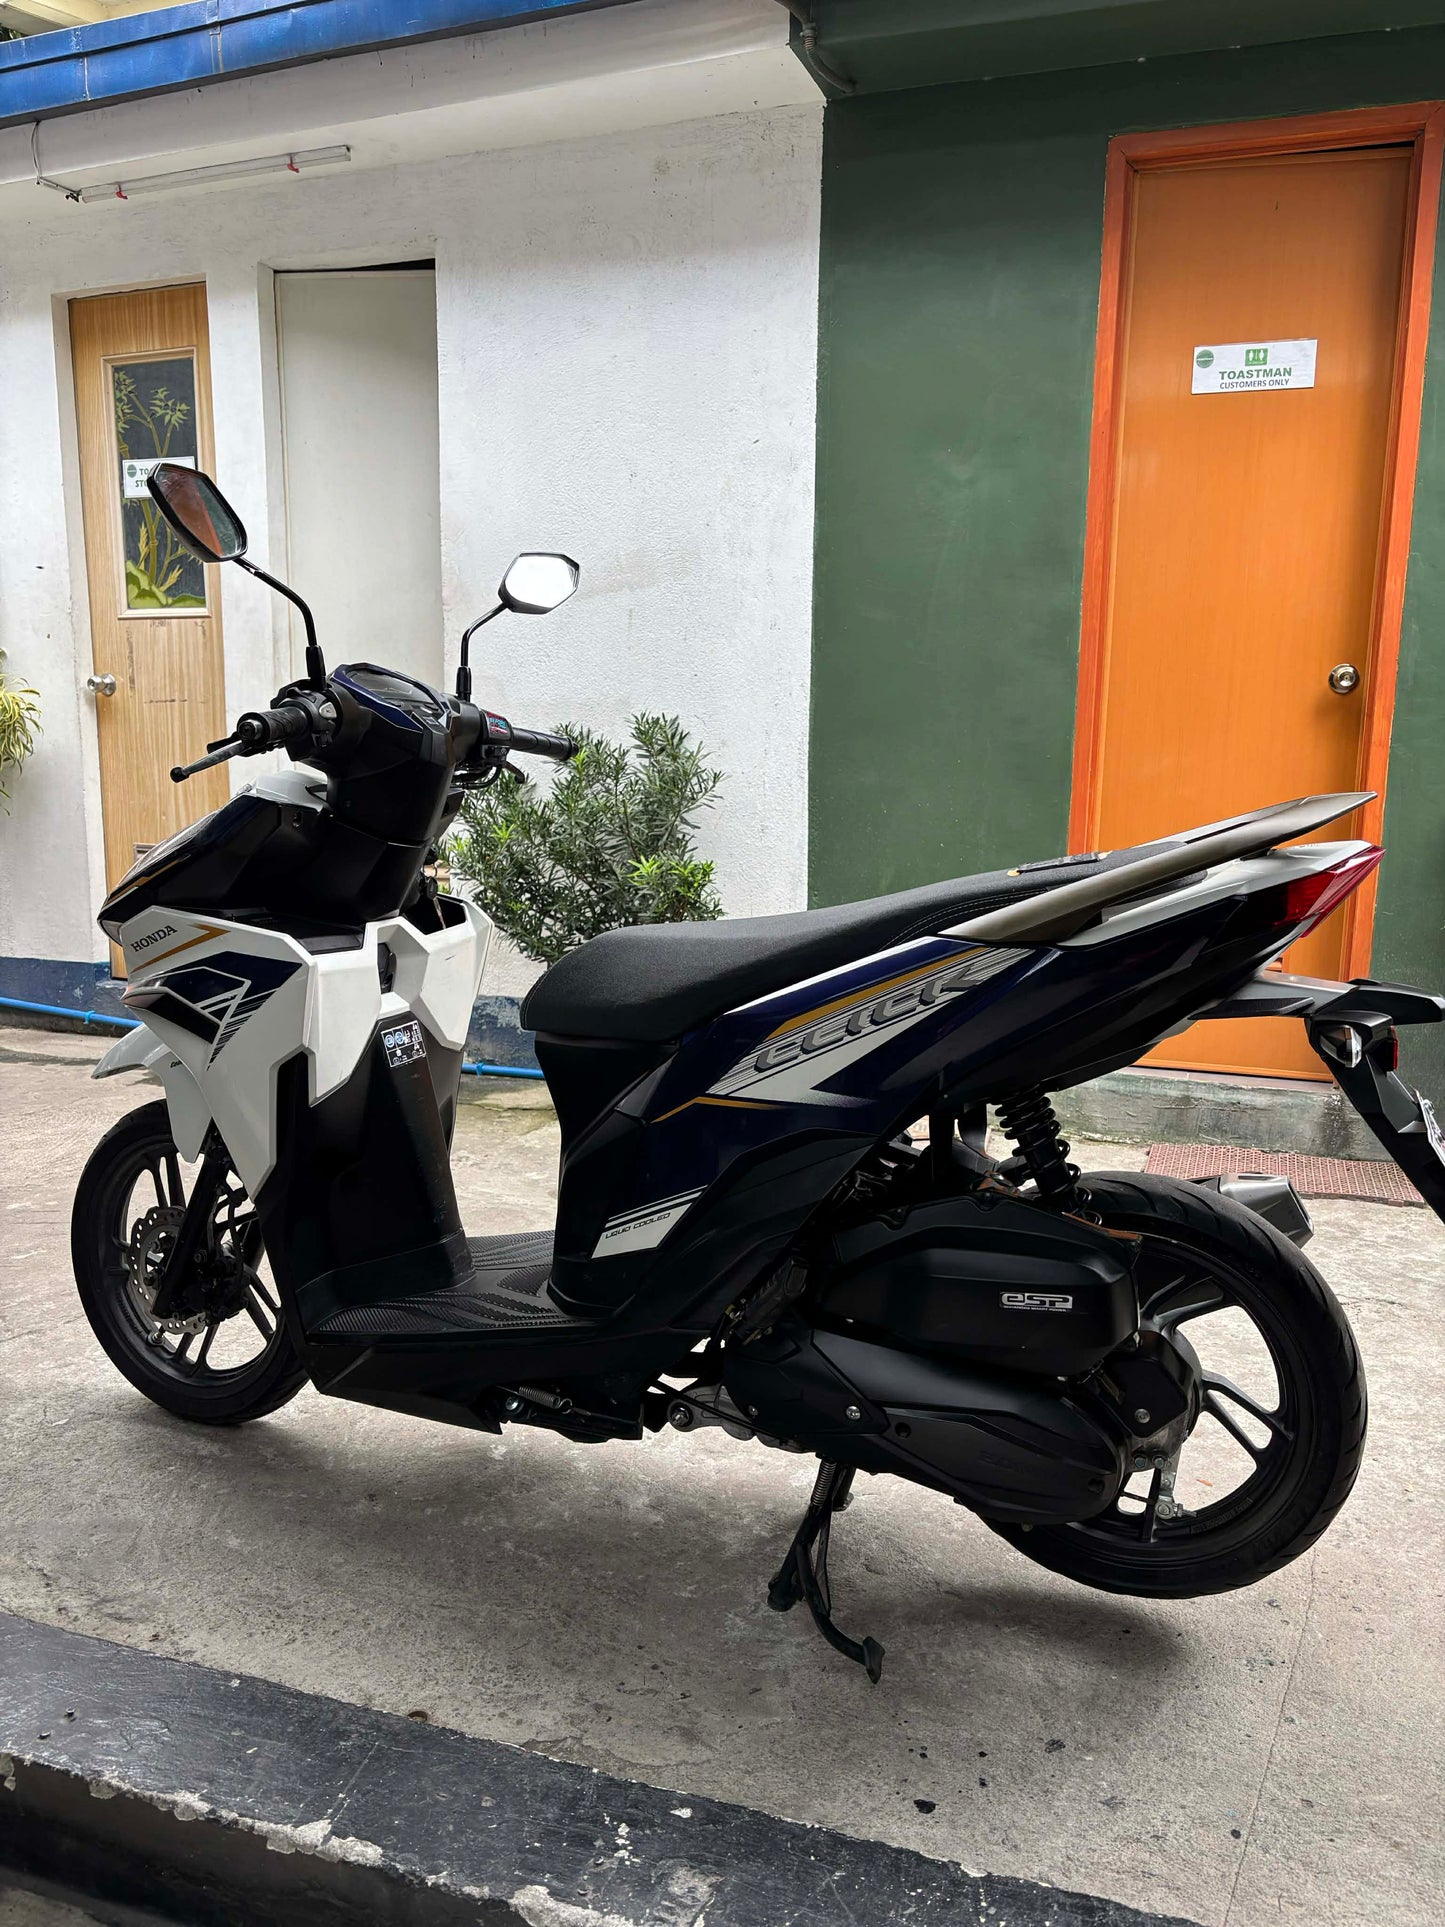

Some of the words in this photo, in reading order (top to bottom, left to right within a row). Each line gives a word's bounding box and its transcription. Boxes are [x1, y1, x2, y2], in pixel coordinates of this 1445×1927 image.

[1219, 367, 1292, 380] TOASTMAN
[1219, 380, 1266, 390] CUSTOMERS
[1268, 378, 1289, 387] ONLY
[139, 468, 149, 476] TO
[130, 925, 178, 952] HONDA
[754, 967, 982, 1073] CLICK
[605, 1226, 631, 1239] LIQUID
[633, 1212, 671, 1229] COOLED
